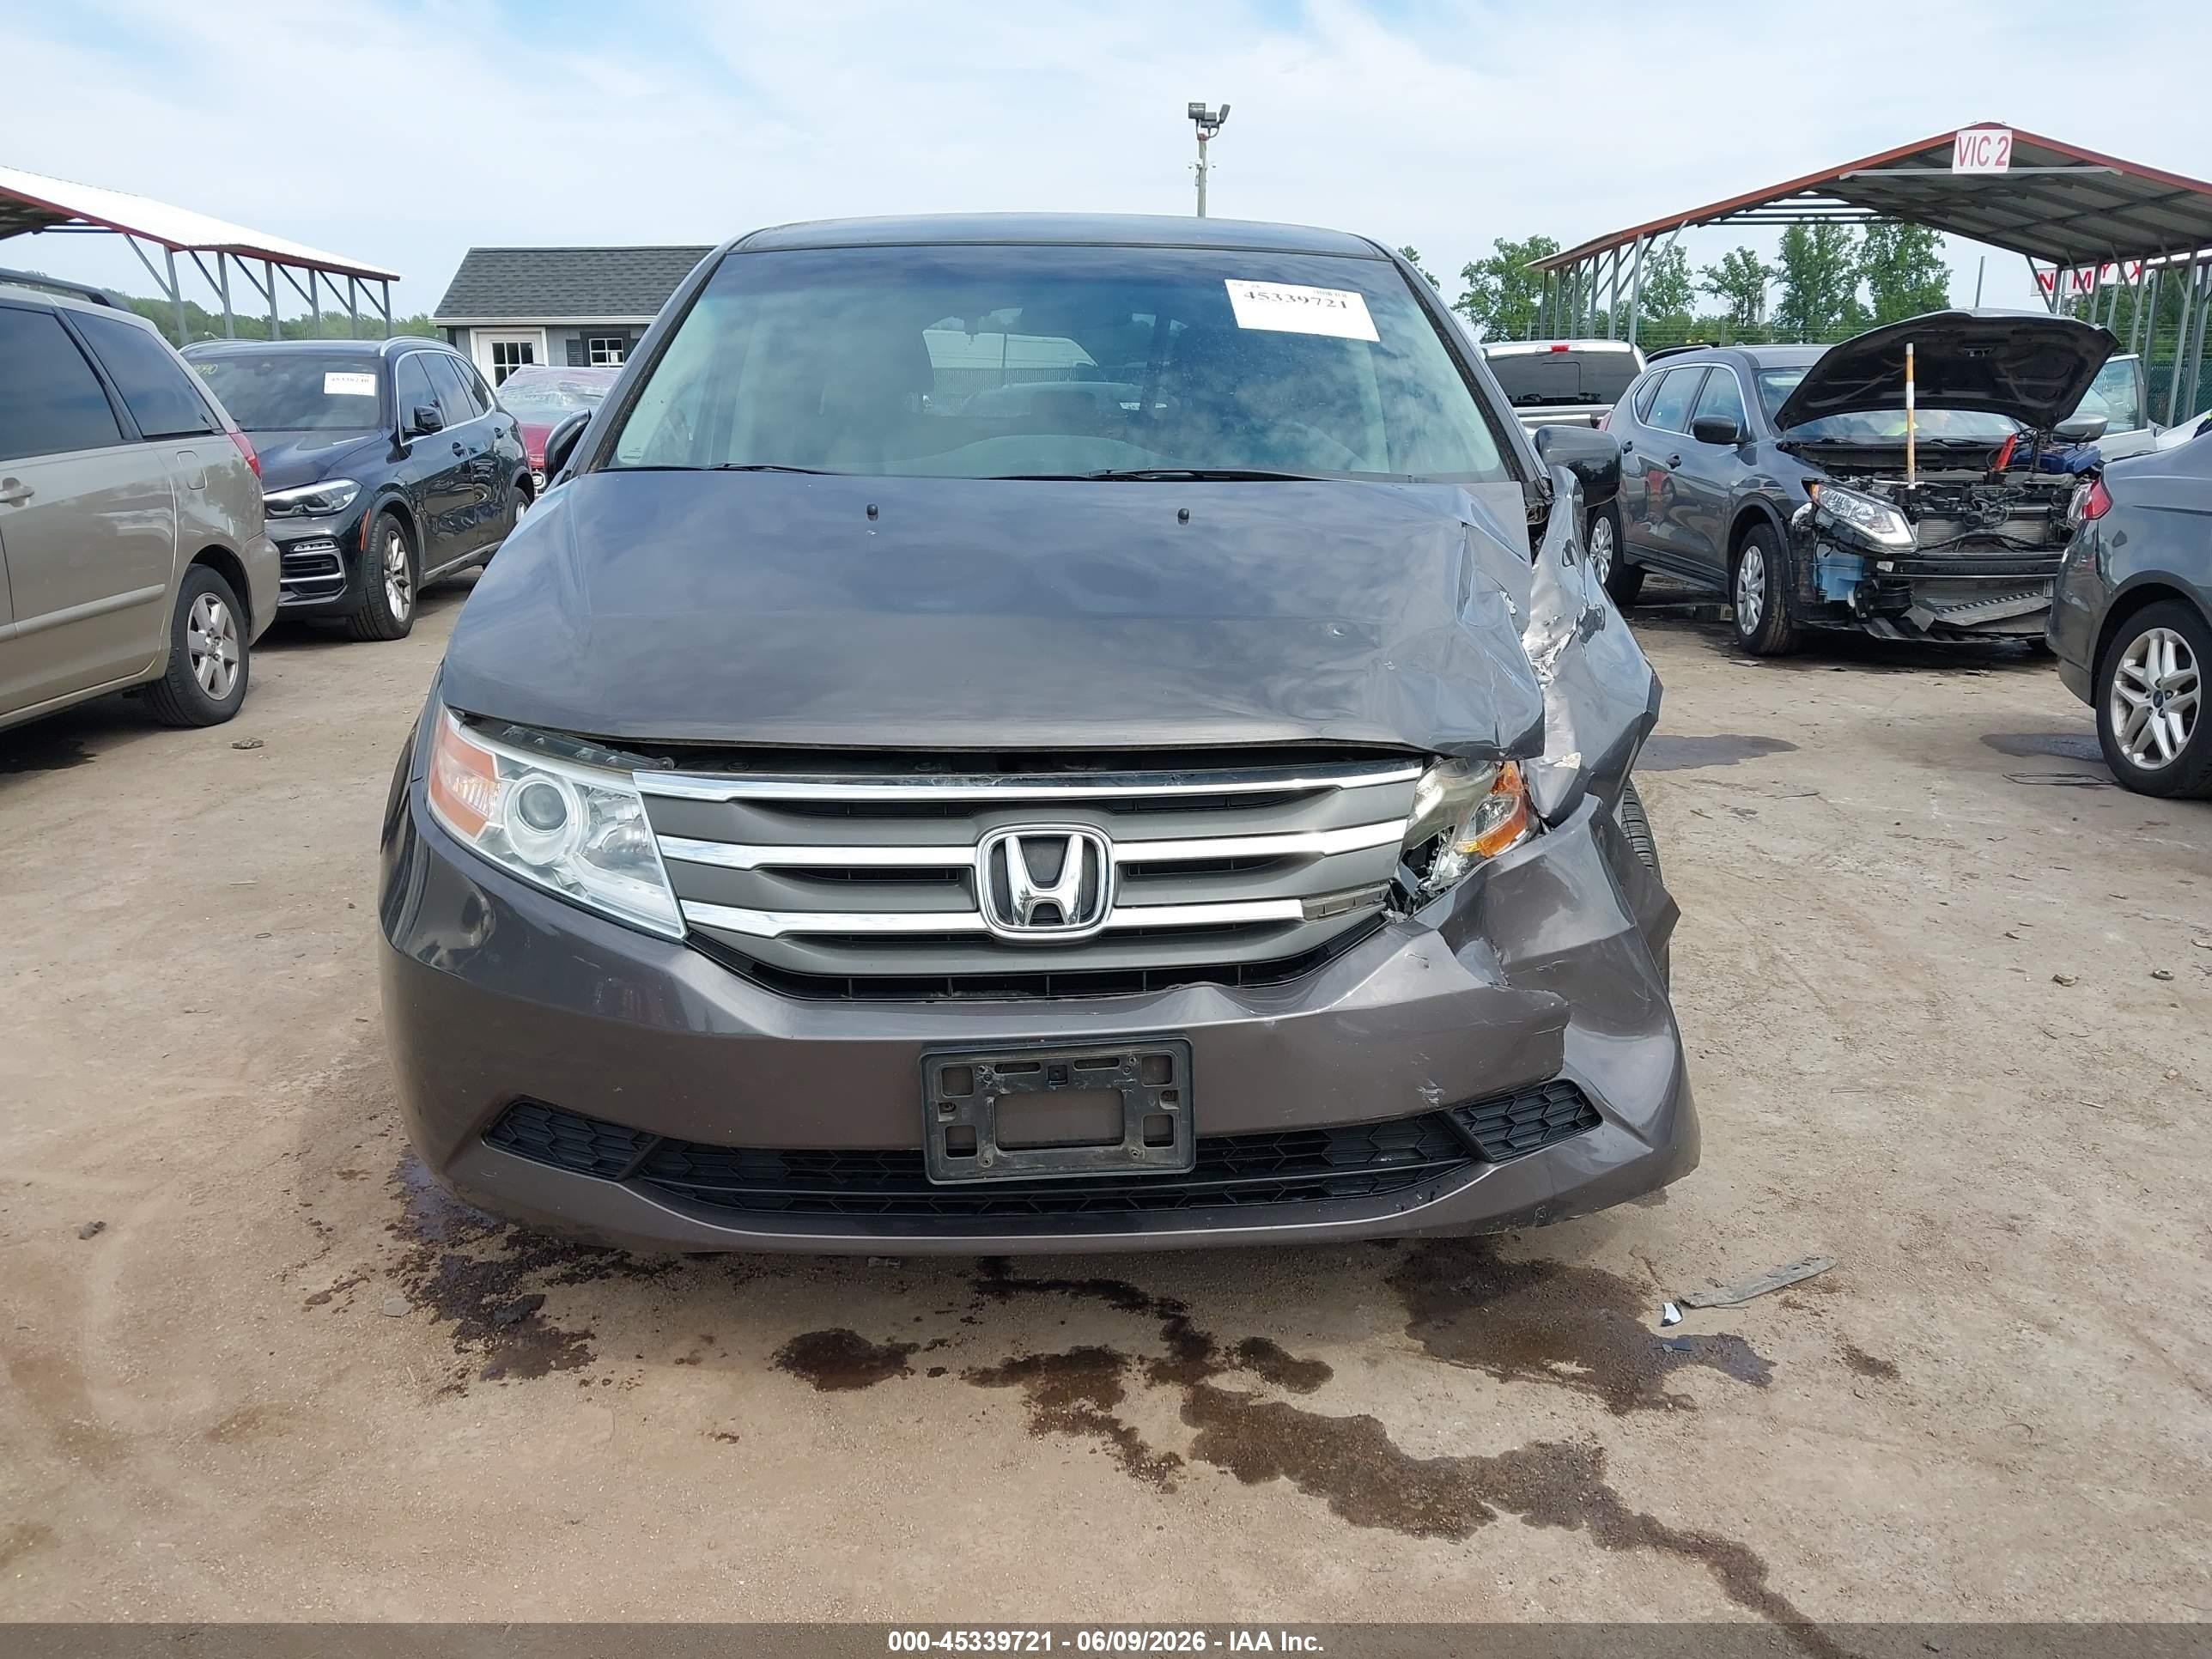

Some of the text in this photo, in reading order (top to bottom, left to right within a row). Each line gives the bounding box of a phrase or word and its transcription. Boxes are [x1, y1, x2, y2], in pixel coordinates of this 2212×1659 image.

[1958, 136, 2009, 167] VIC 2
[2039, 272, 2054, 290] N
[2072, 270, 2093, 289] M
[1243, 290, 1347, 309] 45339721
